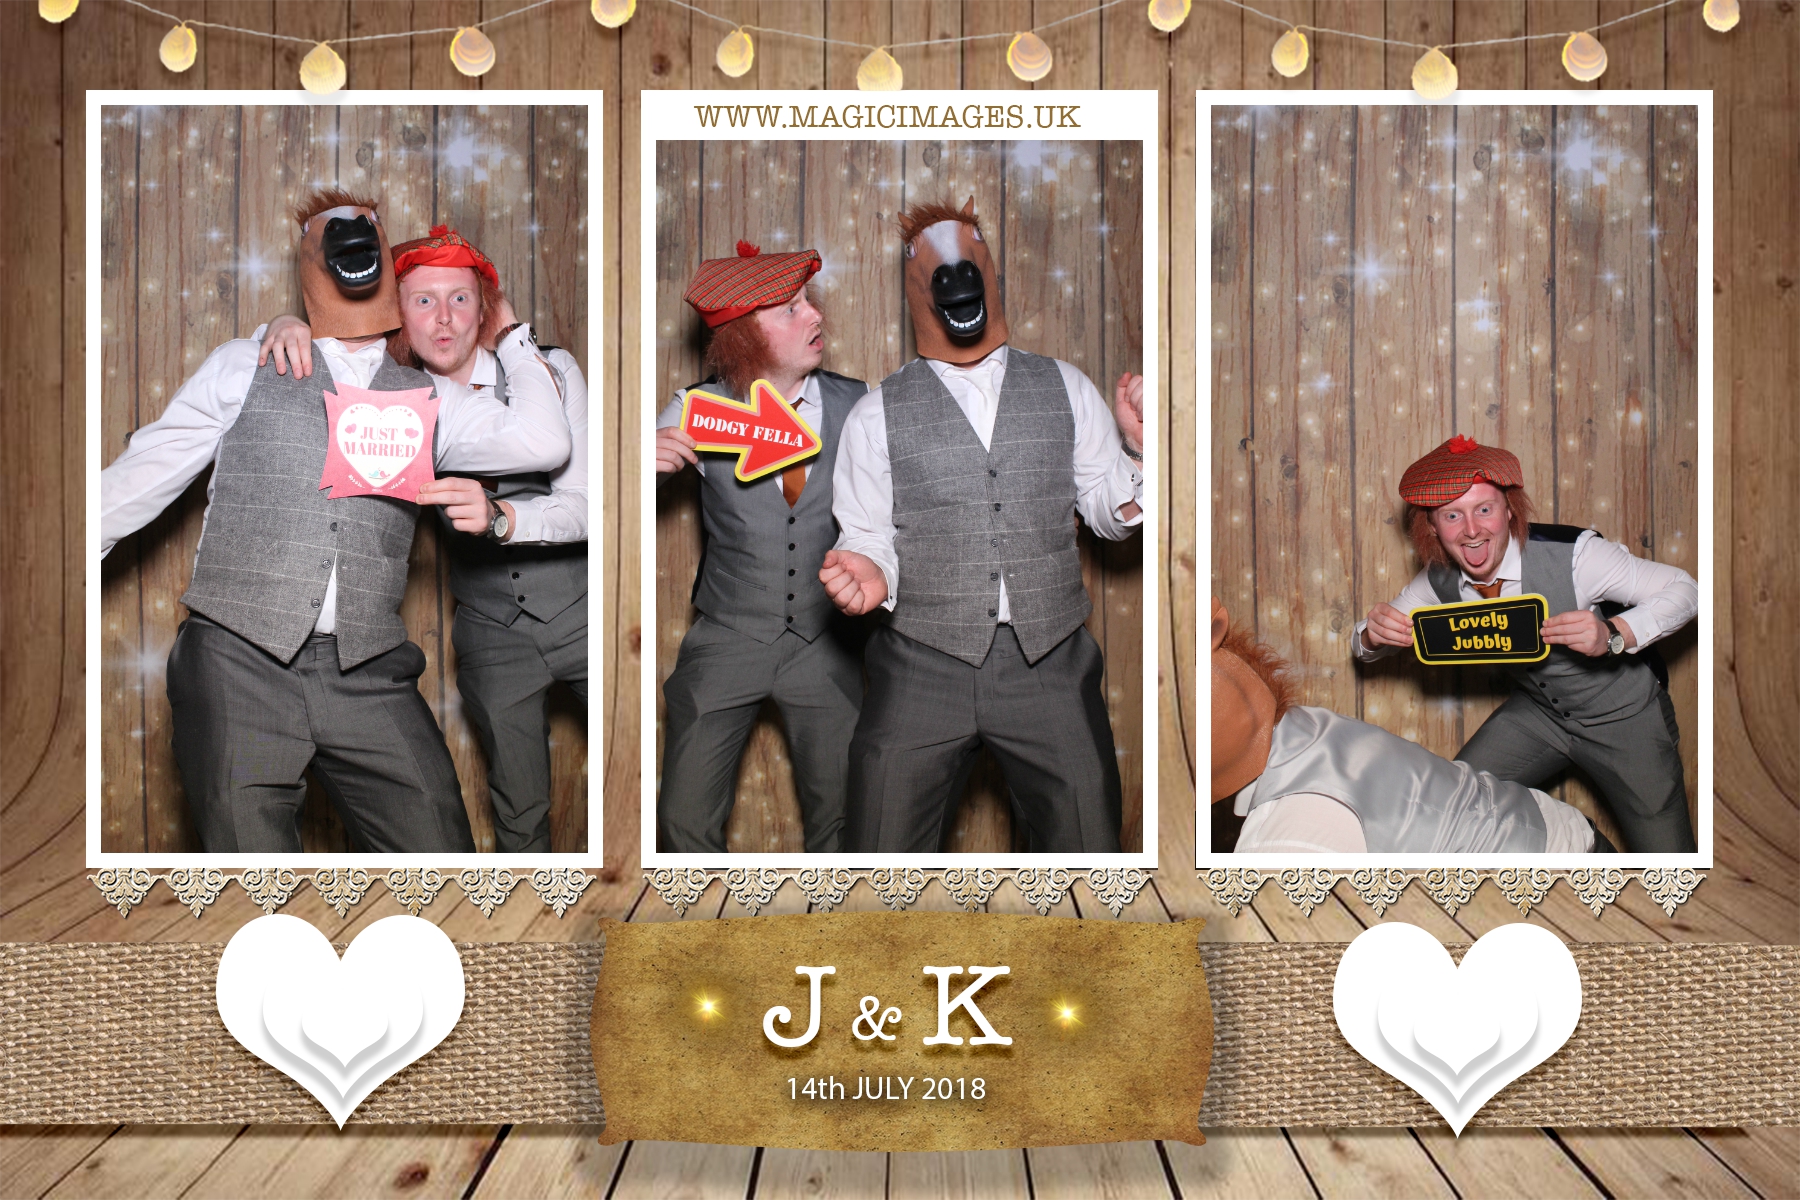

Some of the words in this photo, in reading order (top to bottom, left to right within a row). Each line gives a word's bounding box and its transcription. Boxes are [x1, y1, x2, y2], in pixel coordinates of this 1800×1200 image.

[360, 426, 398, 441] JUST
[692, 413, 750, 437] DODGY
[752, 425, 804, 448] FELLA
[343, 441, 417, 458] MARRIED
[1448, 611, 1509, 632] Lovely
[1452, 633, 1512, 652] Jubbly
